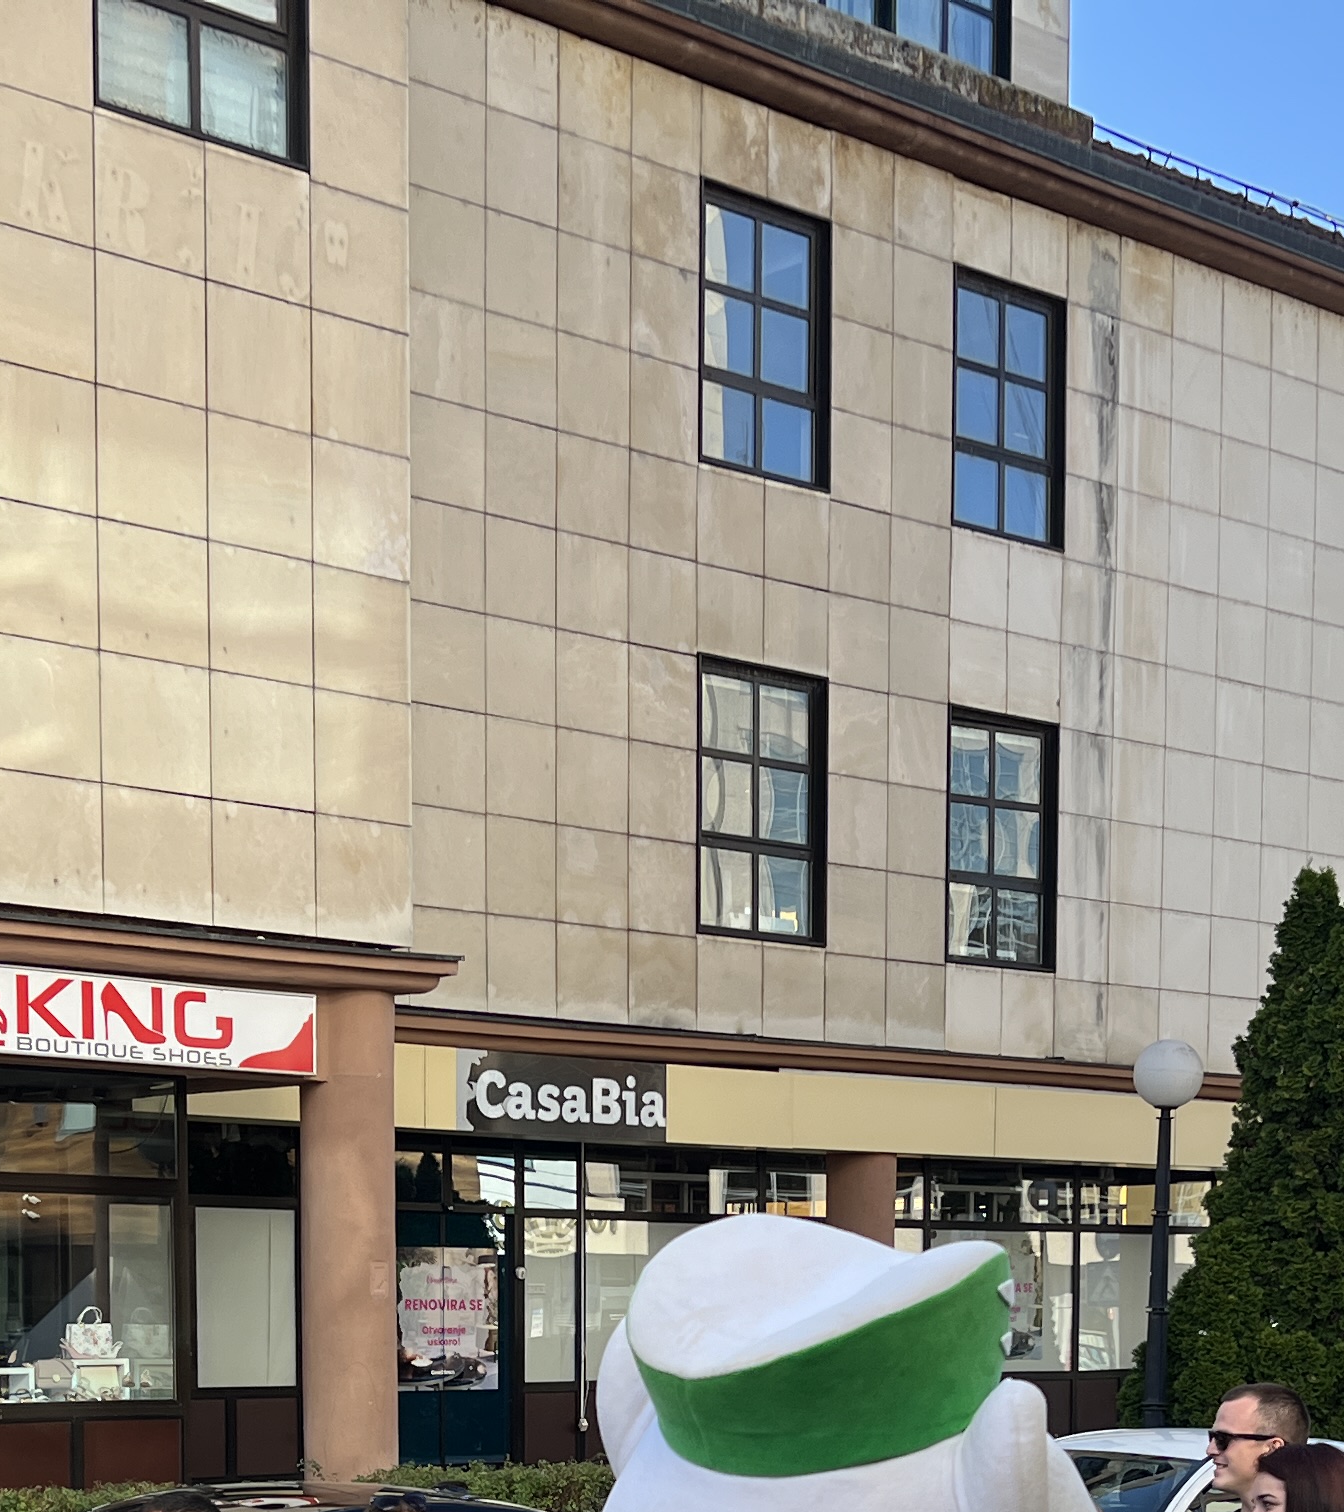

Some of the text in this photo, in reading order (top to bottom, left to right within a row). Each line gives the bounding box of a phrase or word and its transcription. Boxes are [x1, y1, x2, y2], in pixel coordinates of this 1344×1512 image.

[15, 974, 233, 1049] KING
[16, 1036, 233, 1067] BOUTIQUE SHOES
[475, 1069, 667, 1128] CasaBia
[404, 1299, 483, 1311] RENOVIRA SE
